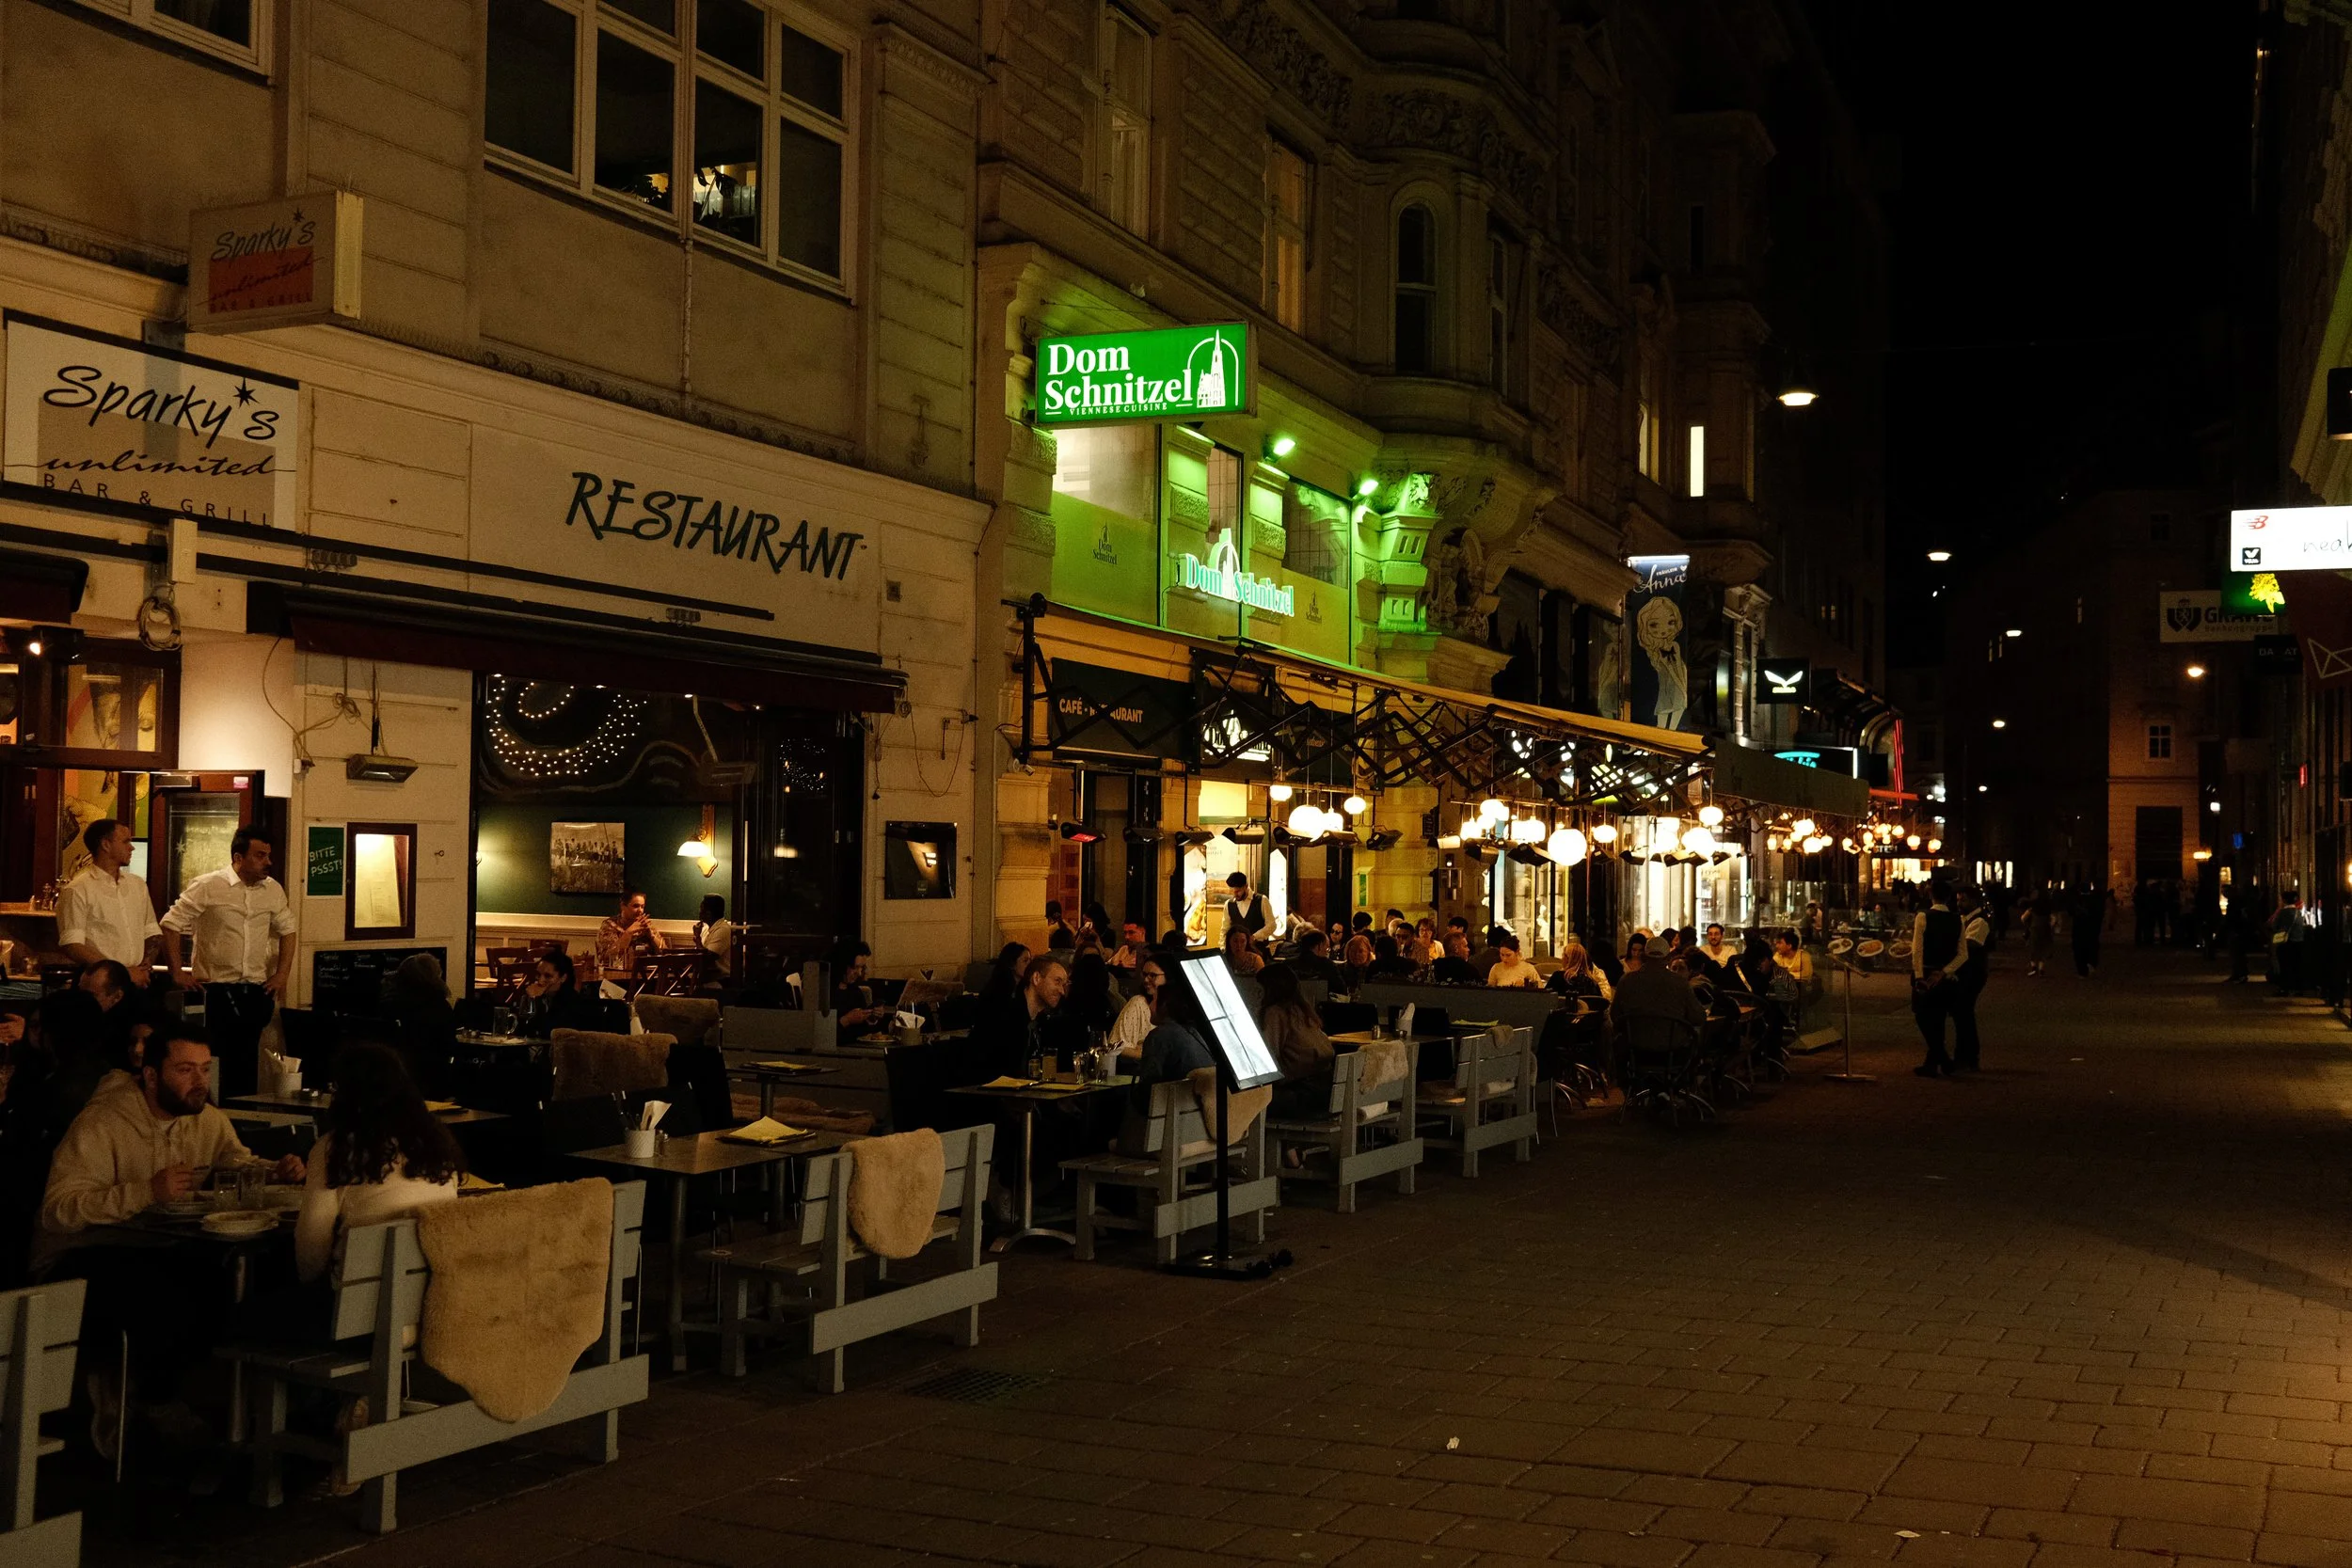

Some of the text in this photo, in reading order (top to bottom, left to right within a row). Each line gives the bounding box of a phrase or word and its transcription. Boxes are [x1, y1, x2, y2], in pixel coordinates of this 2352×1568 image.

[210, 293, 312, 313] BAR & GRILL
[1047, 344, 1131, 376] Dom
[1044, 369, 1193, 410] Schnitzel
[1069, 402, 1168, 416] VIENNESE CUISINE
[45, 449, 275, 477] unlimited
[43, 473, 273, 529] BAR & GRILL
[565, 471, 865, 580] RESTAURANT
[1185, 553, 1223, 597] Dom
[1633, 563, 1688, 594] Anna
[1232, 569, 1295, 618] Schnitzel
[1058, 696, 1143, 723] CAFÉ RAURANT
[309, 846, 336, 863] BITTE
[310, 858, 342, 878] PSSST!
